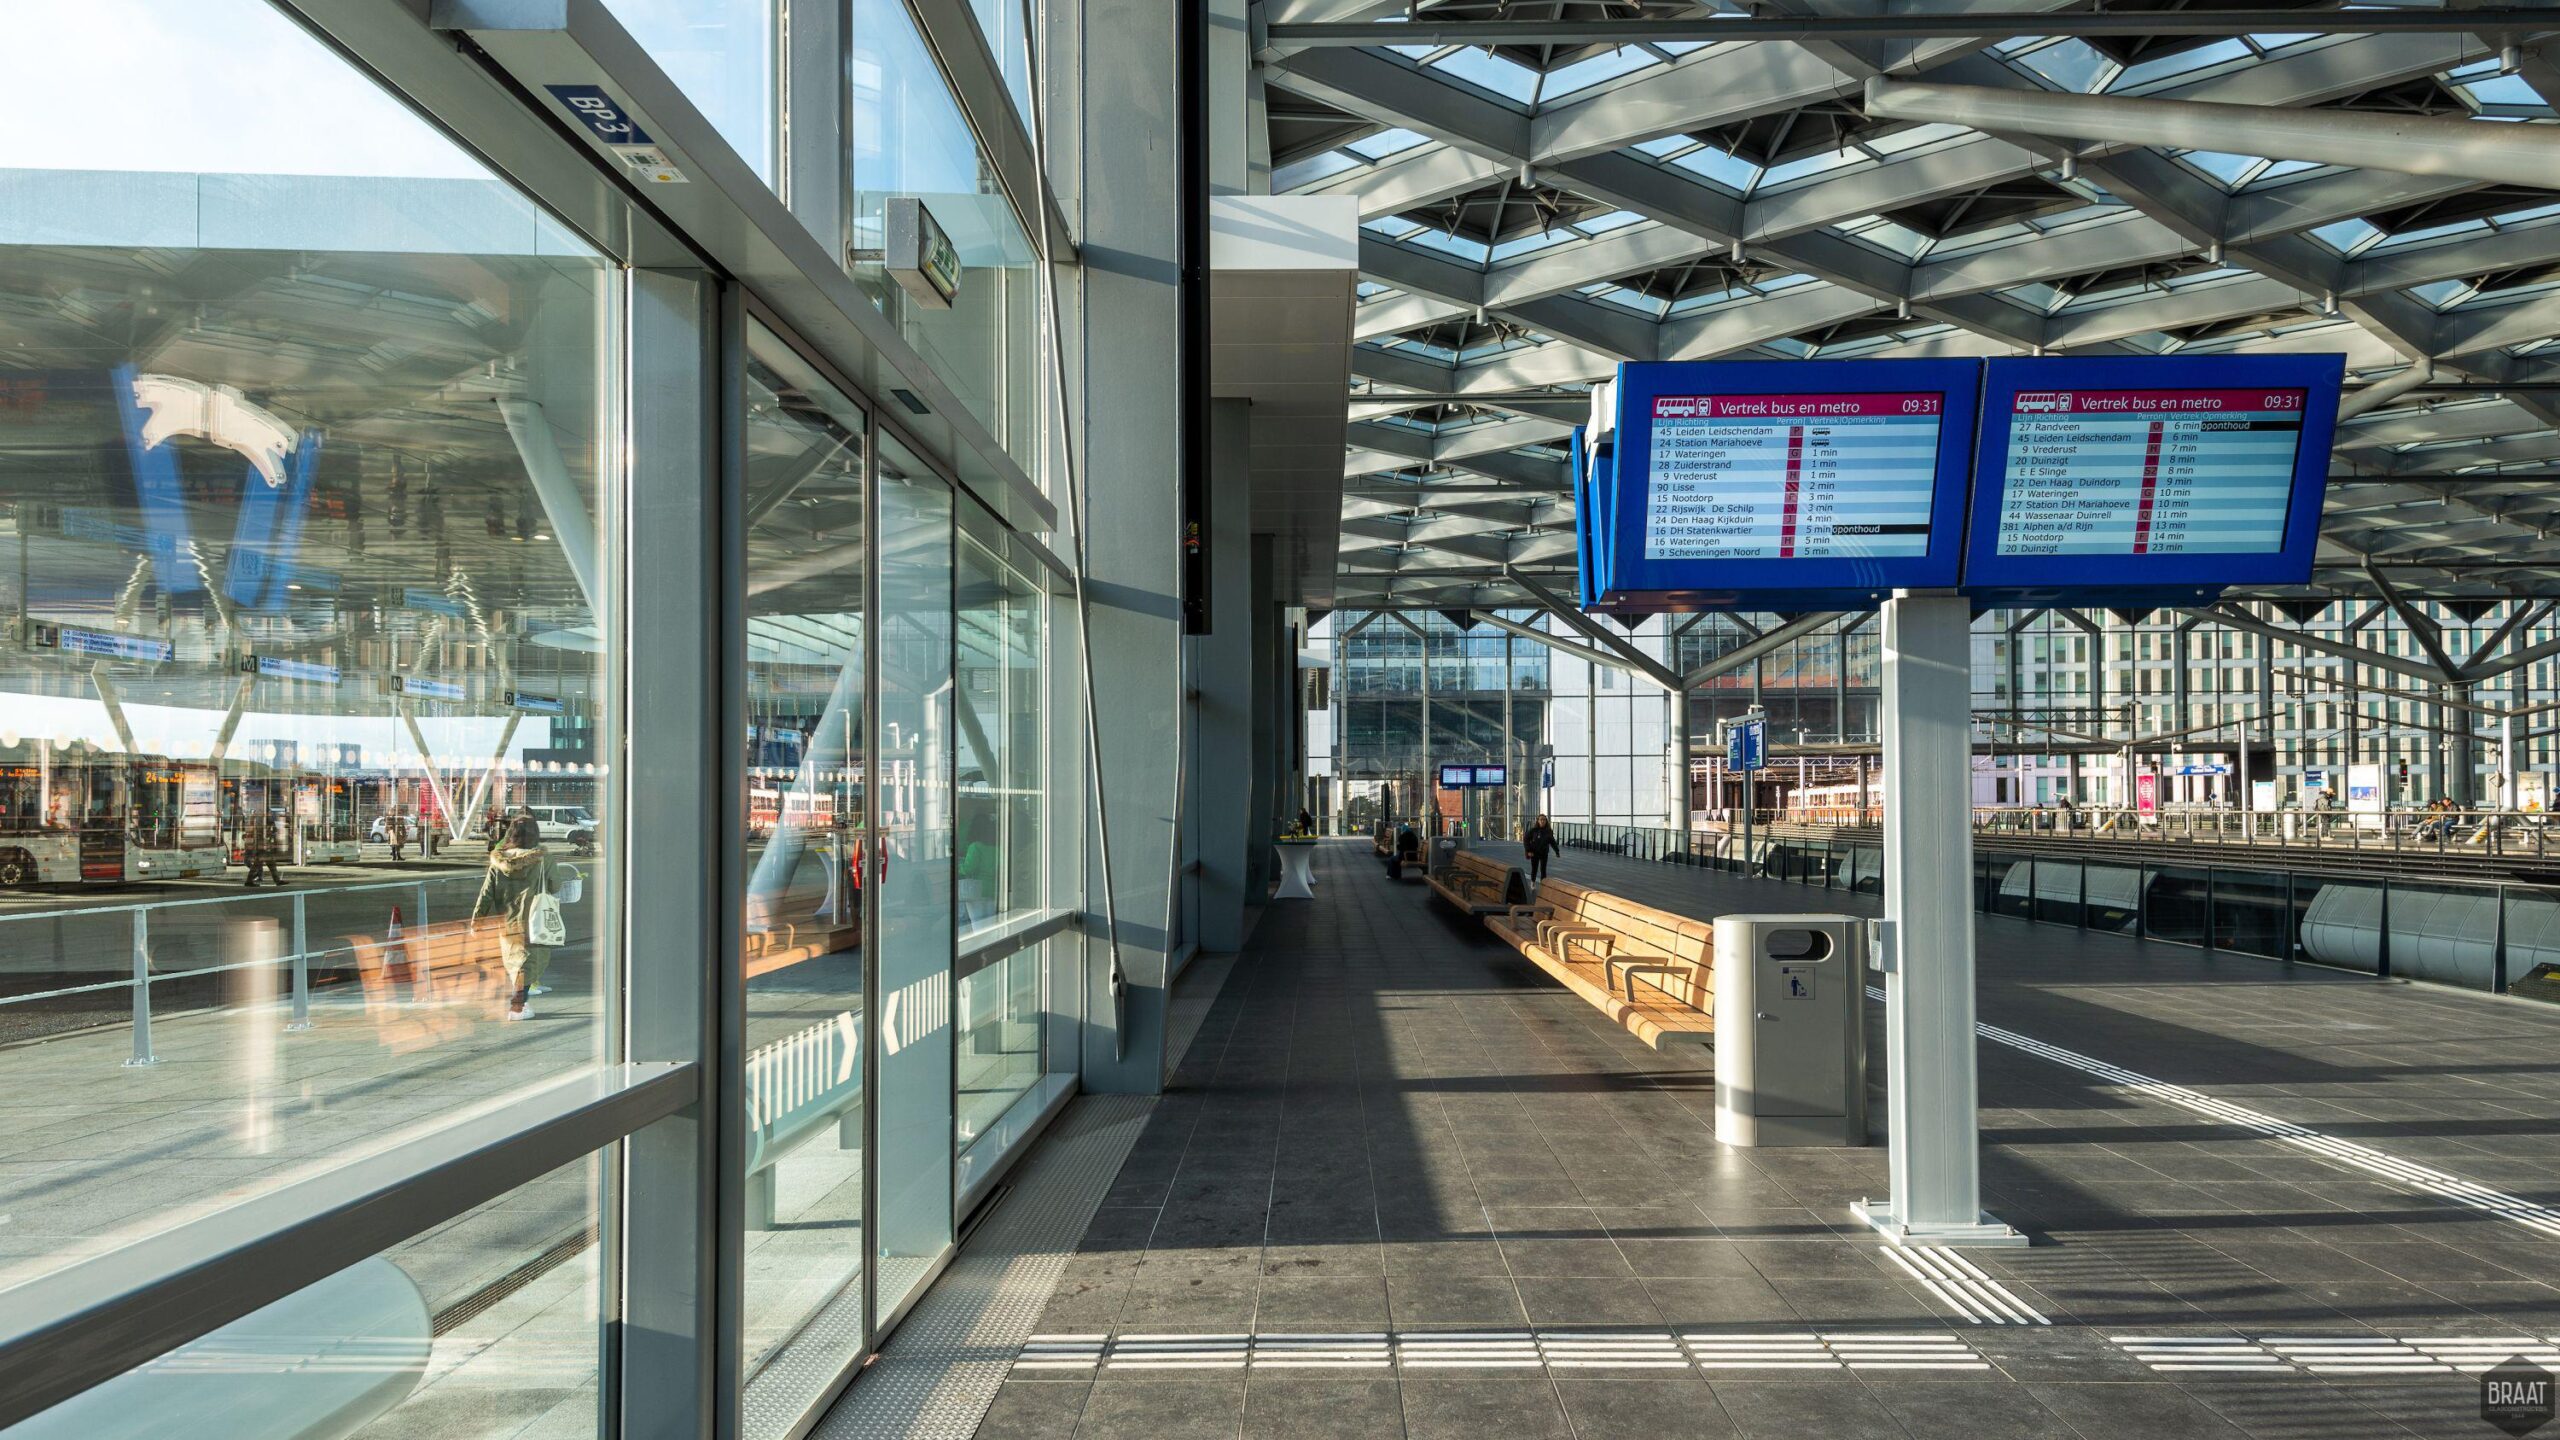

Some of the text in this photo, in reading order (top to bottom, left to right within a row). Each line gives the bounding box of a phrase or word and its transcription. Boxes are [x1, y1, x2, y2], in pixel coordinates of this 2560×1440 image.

[567, 96, 630, 134] BP 3
[1902, 400, 1937, 412] 09:31
[2082, 396, 2222, 410] Vertrek bus en metro
[2264, 396, 2300, 408] 09:31
[1720, 401, 1860, 414] Vertrek bus en metro
[2019, 423, 2031, 431] 27
[2035, 422, 2080, 431] Randveen
[2174, 422, 2180, 430] 6
[2183, 422, 2200, 430] min
[2201, 421, 2250, 431] oponthoud
[1660, 428, 1671, 436] 45
[1709, 427, 1773, 435] Leidschendam
[2018, 433, 2198, 442] 45 Leiden Leidschendam 6 min
[1675, 439, 1707, 447] Station
[2032, 445, 2077, 453] Vrederust
[2172, 444, 2177, 452] 7
[2180, 444, 2196, 452] min
[1675, 451, 1726, 459] Wateringen
[1674, 461, 1731, 469] Zuiderstrand
[1820, 460, 1836, 468] min
[2016, 457, 2027, 465] 20
[2031, 457, 2068, 466] Duinzigt
[2170, 456, 2175, 464] 8
[2178, 456, 2195, 464] min
[1673, 472, 1717, 480] Vrederust
[1819, 471, 1835, 479] min
[2039, 467, 2067, 477] Slinge
[1657, 484, 1668, 492] 90
[1818, 482, 1835, 490] min
[2013, 478, 2192, 488] 22 Den Haag Duindorp 9 min
[1657, 495, 1667, 503] 15
[1672, 494, 1713, 504] Nootdorp
[2012, 489, 2190, 499] 17 Wateringen G 10 min
[1656, 504, 1833, 515] 22 Rijswijk De Schilp 3 min
[2010, 501, 2022, 509] 27
[2026, 501, 2058, 509] Station
[2061, 501, 2075, 509] DH
[2078, 500, 2130, 508] Mariahoeve
[2158, 500, 2169, 508] 10
[2172, 500, 2189, 508] min
[1670, 516, 1688, 524] Den
[1692, 516, 1714, 525] Haag
[1717, 515, 1753, 525] Kijkduin
[1807, 515, 1812, 523] 4
[1815, 515, 1832, 523] min
[2076, 511, 2112, 519] Duinrell
[1656, 525, 1880, 535] 16 DH Statenkwartier 5 min oponthoud
[2002, 523, 2018, 531] 381
[2023, 522, 2054, 532] Alphen
[2057, 522, 2072, 530] a/d
[2076, 522, 2093, 532] Rijn
[1655, 538, 1665, 546] 16
[1670, 538, 1720, 547] Wateringen
[1785, 537, 1791, 545] H
[1805, 537, 1810, 545] 5
[2022, 533, 2064, 543] Nootdorp
[1669, 548, 1730, 558] Scheveningen
[1733, 548, 1760, 556] Noord
[2005, 545, 2017, 553] 20
[2021, 545, 2058, 554] Duinzigt
[2152, 544, 2164, 552] 23
[42, 629, 52, 644] L
[243, 656, 255, 671] M
[392, 678, 401, 692] N
[146, 771, 157, 783] 24
